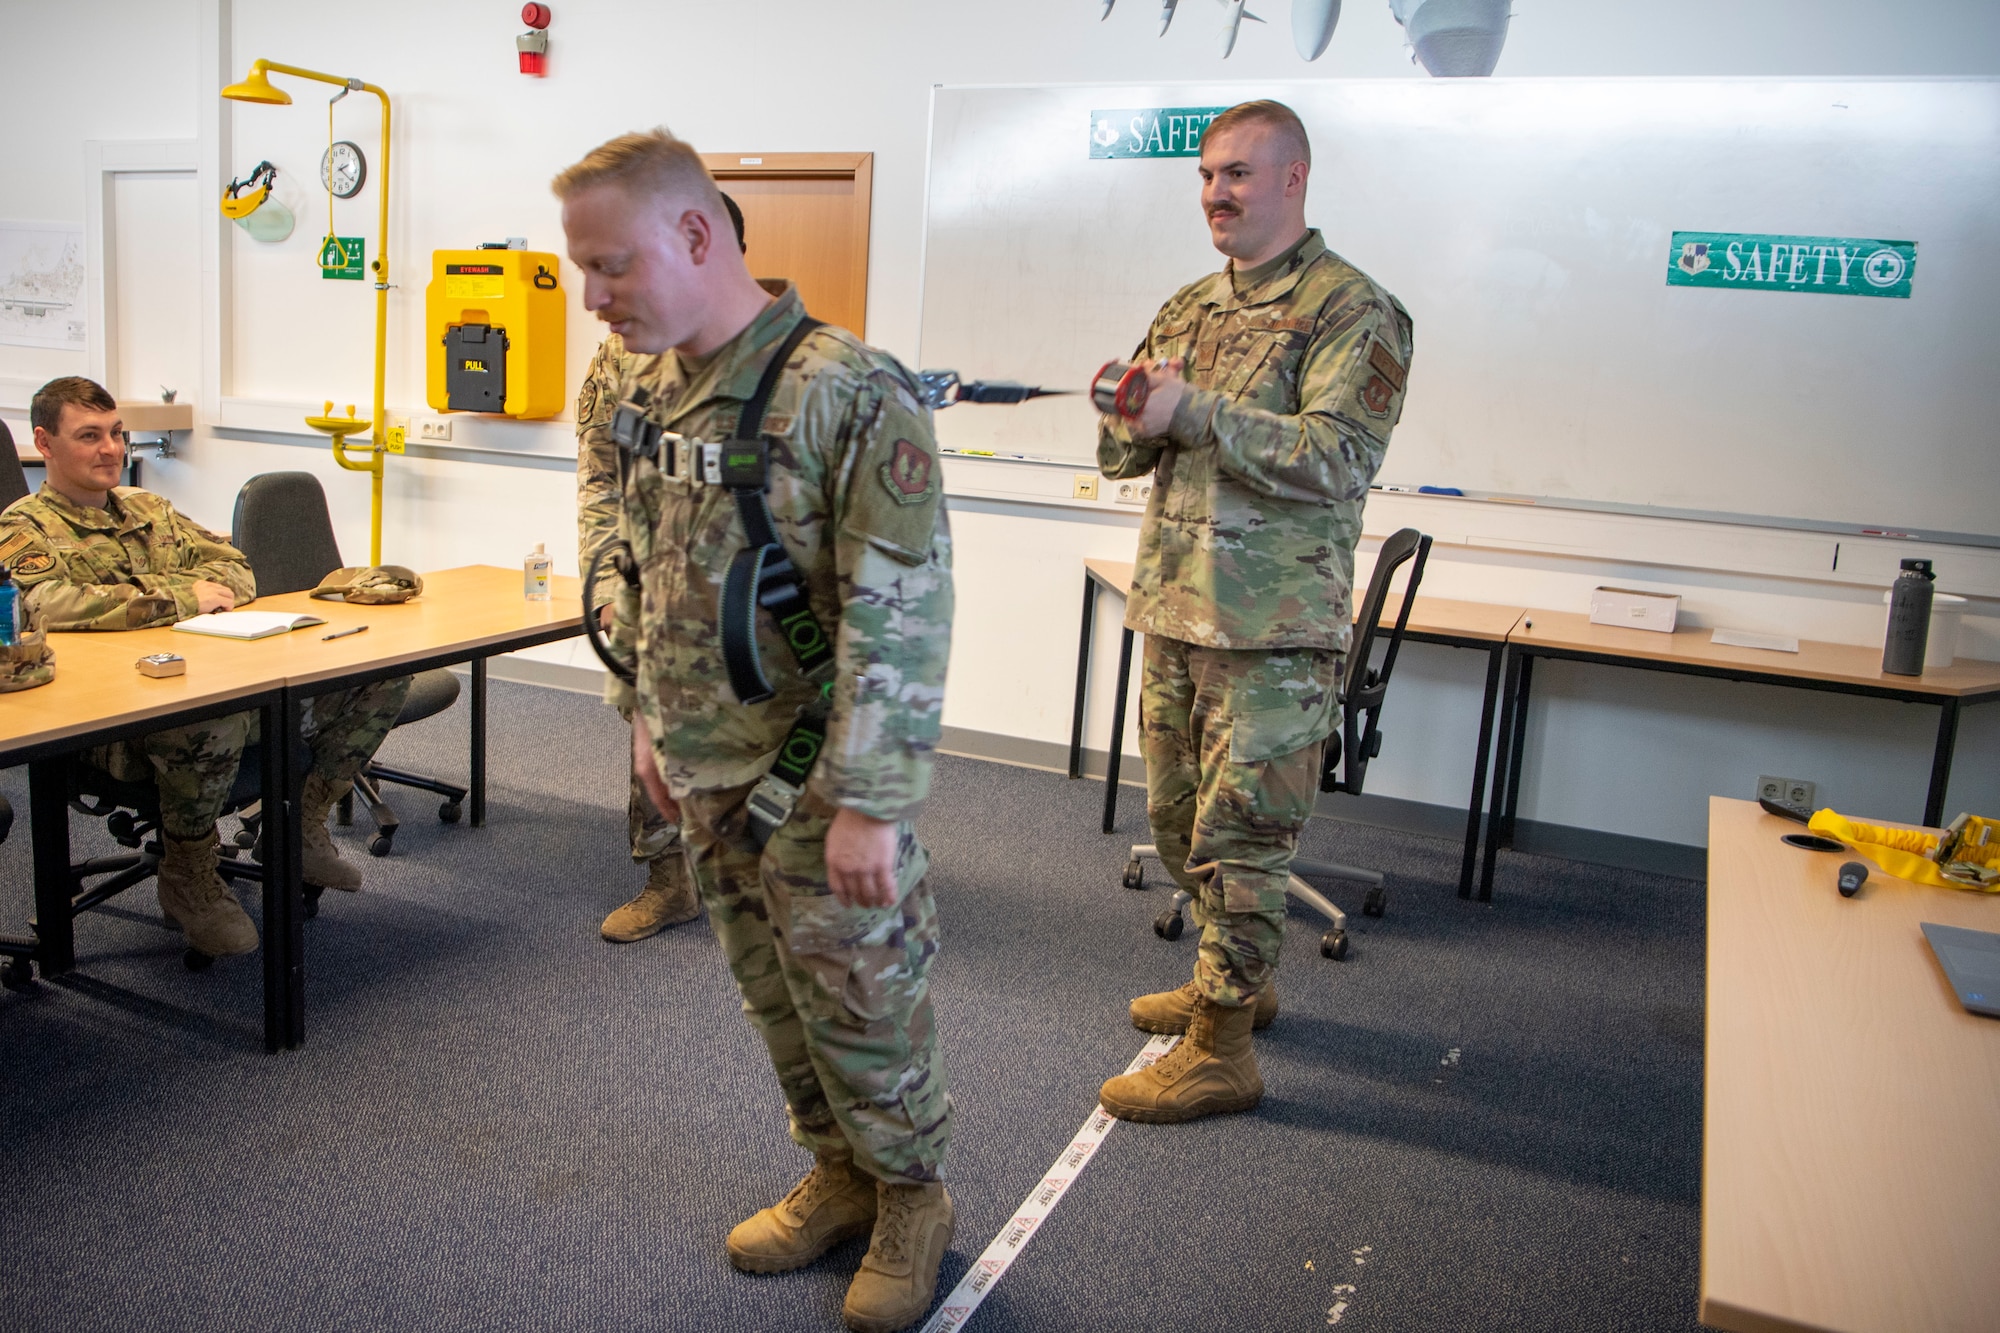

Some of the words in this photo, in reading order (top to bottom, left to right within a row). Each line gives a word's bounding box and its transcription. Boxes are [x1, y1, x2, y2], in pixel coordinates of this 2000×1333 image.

[1128, 112, 1219, 153] SAFE
[1723, 241, 1860, 286] SAFETY
[465, 360, 484, 370] PULL
[1068, 1150, 1086, 1169] MSF
[1038, 1187, 1057, 1207] MSF
[1006, 1226, 1027, 1249] MSF
[971, 1269, 993, 1294] MSF
